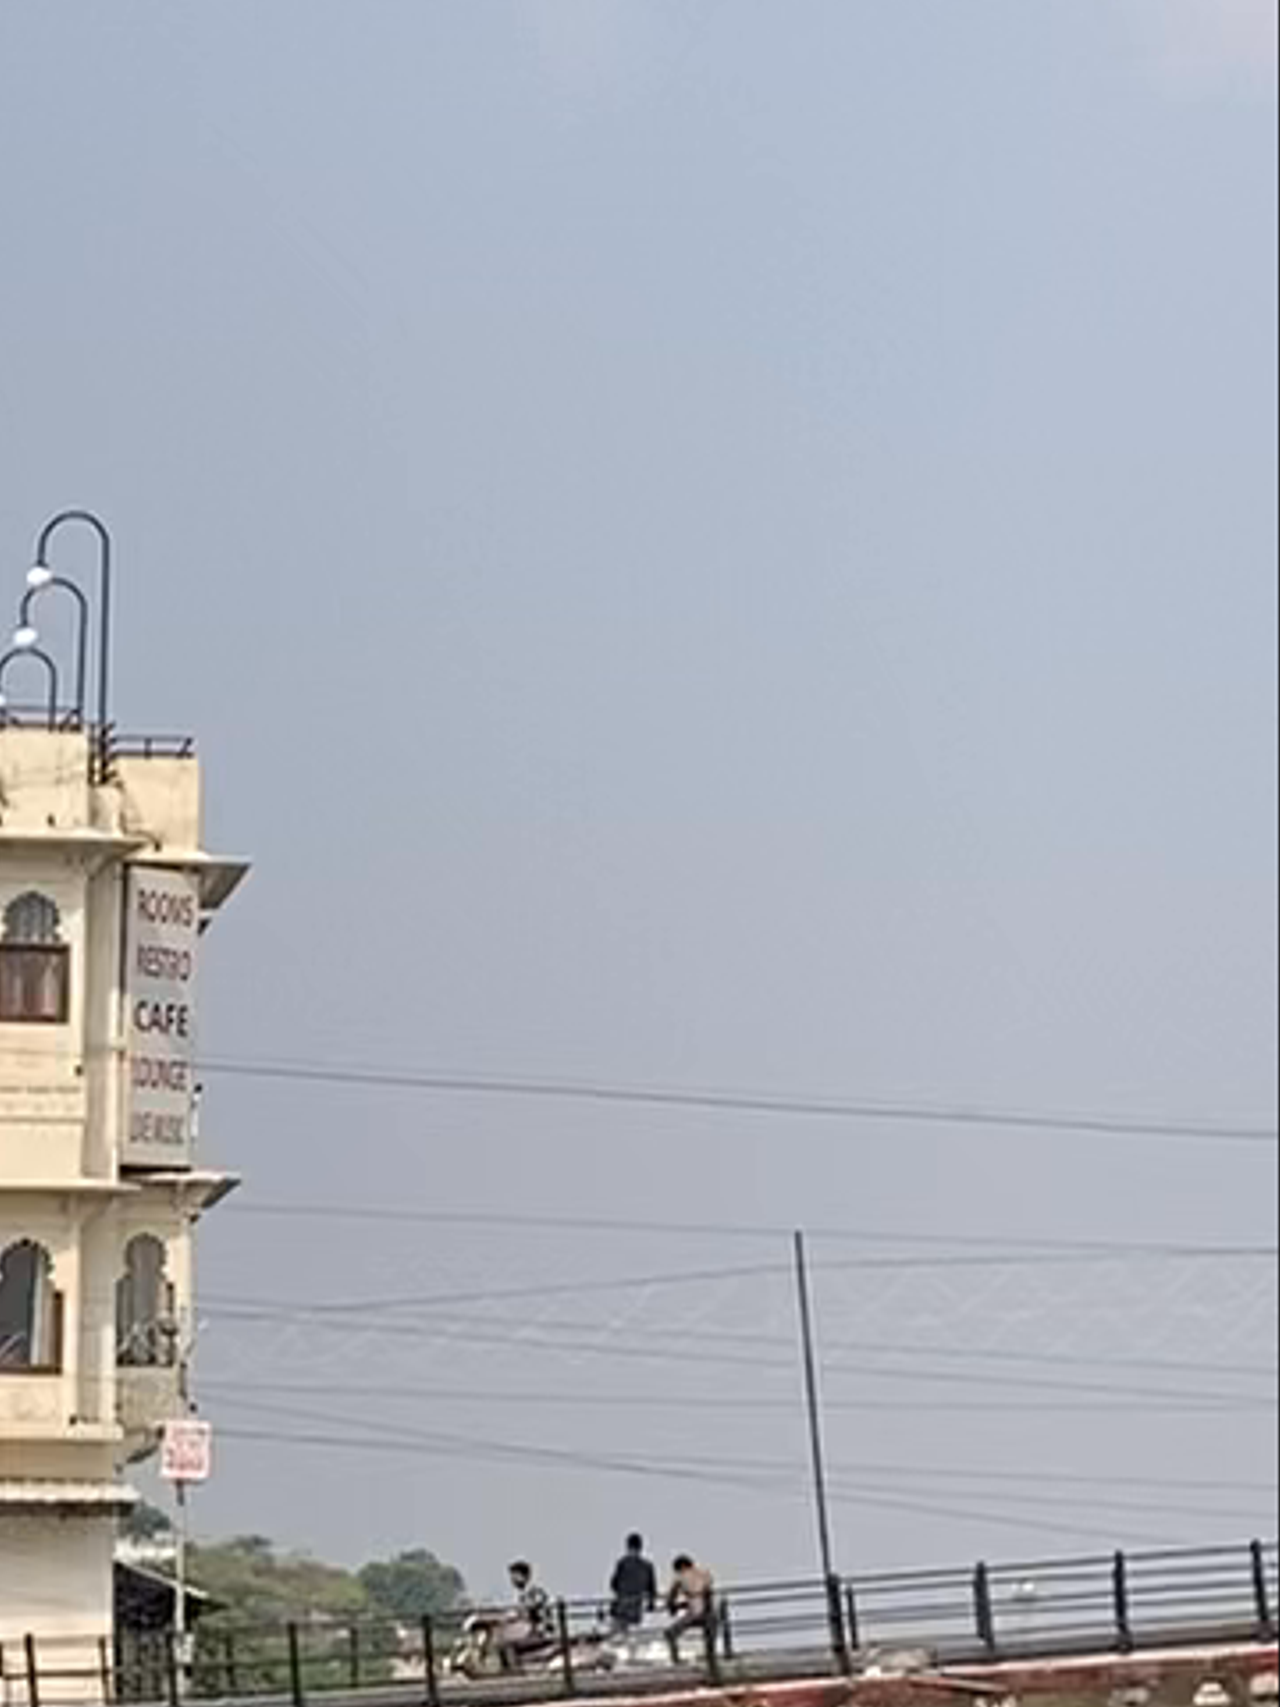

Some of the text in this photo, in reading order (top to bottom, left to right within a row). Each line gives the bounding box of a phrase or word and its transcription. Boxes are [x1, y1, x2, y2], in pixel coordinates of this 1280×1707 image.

[137, 887, 192, 928] ROOMS
[136, 943, 191, 981] RESTRO
[134, 999, 188, 1037] CAFE
